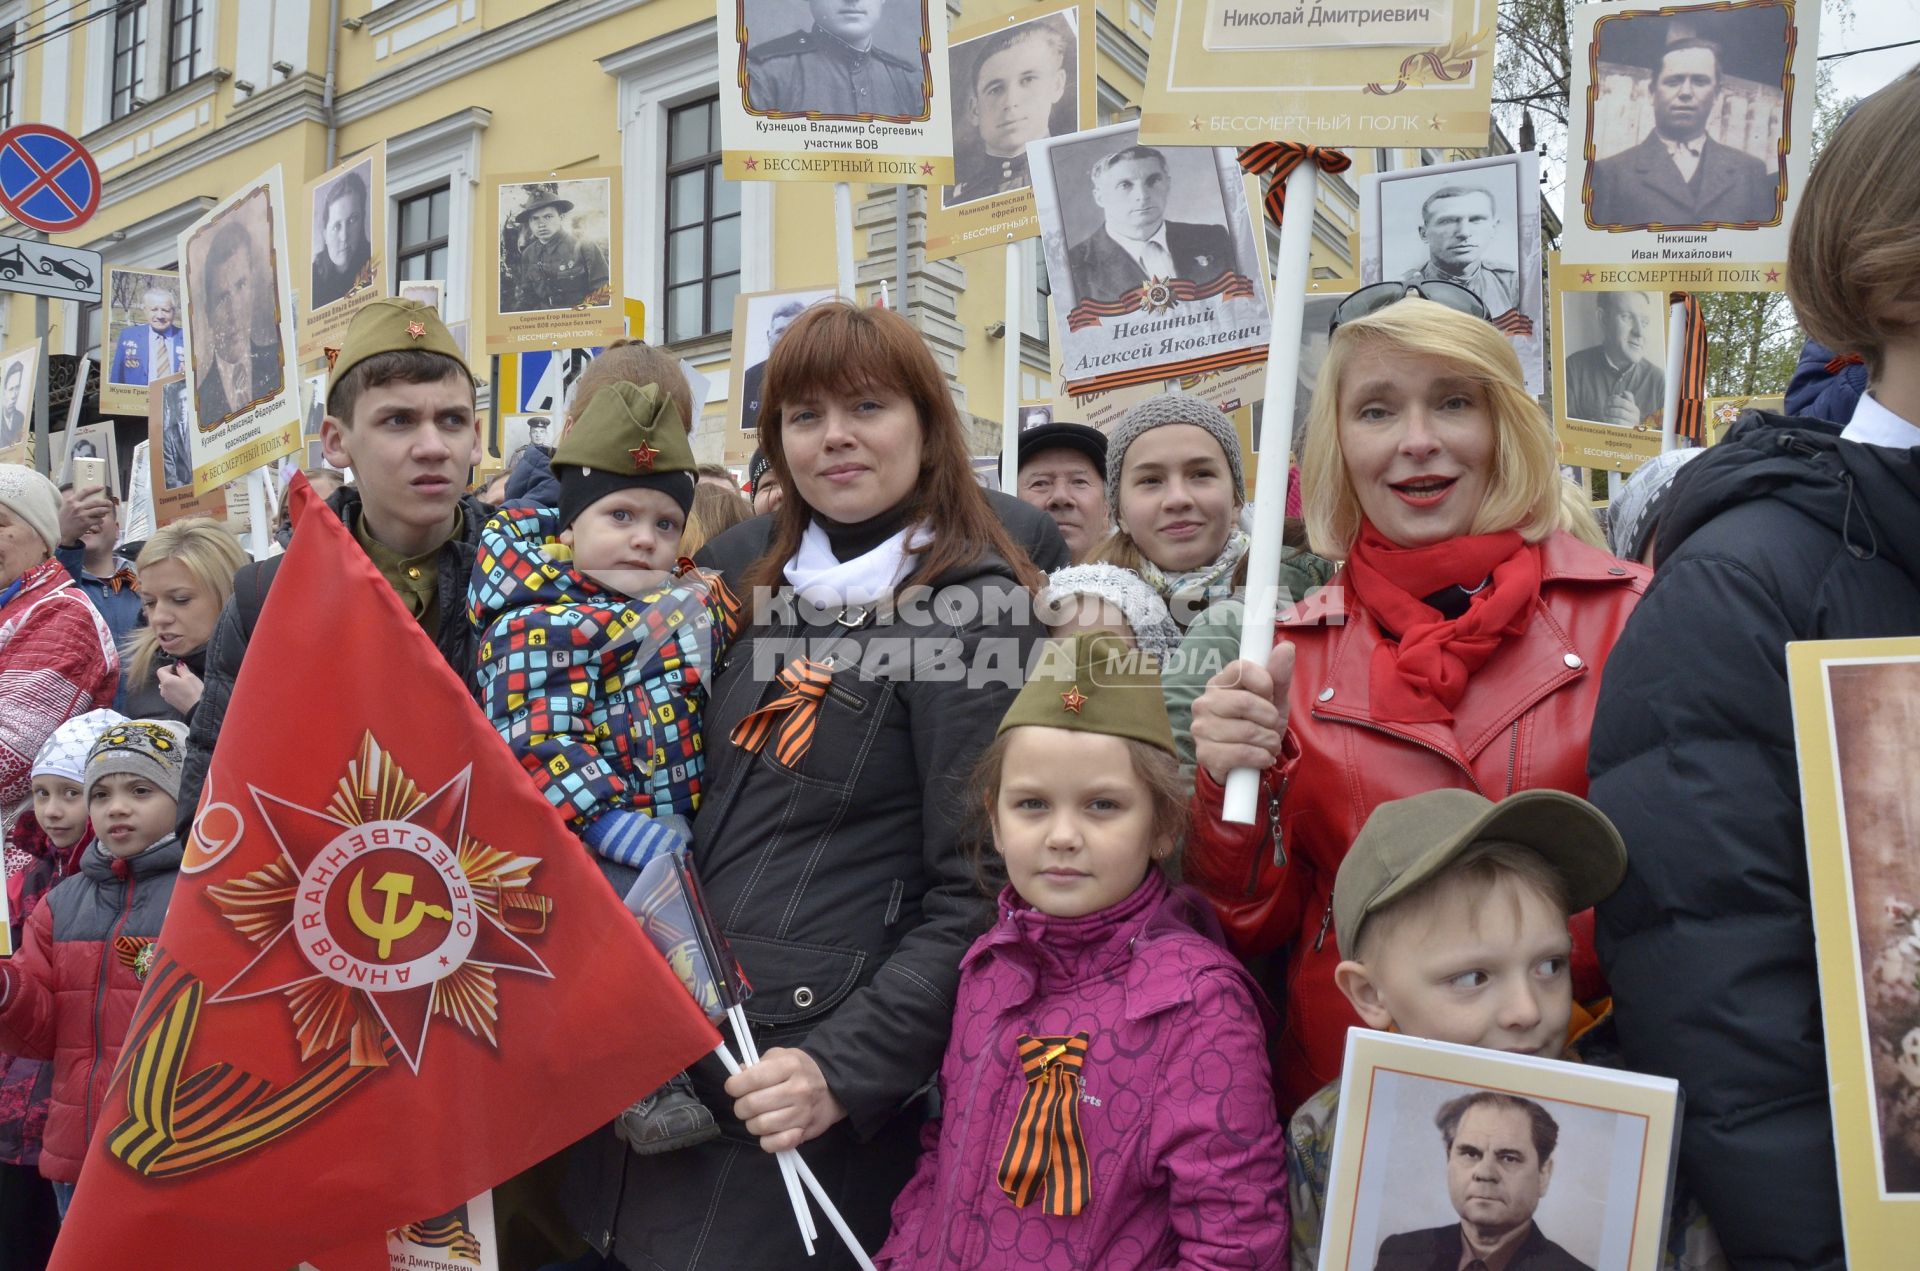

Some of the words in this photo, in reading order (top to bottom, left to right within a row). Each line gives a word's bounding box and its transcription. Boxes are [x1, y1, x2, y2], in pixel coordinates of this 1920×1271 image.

[1223, 6, 1304, 26] Николай
[1308, 6, 1429, 27] Дмитриевич
[756, 120, 807, 133] Кузнецов
[810, 122, 865, 135] Владимир
[868, 124, 924, 136] Сергеевич
[1210, 113, 1350, 131] БЕССМЕРТНЫЙ
[1359, 115, 1420, 130] ПОЛК
[804, 139, 852, 149] участник
[855, 139, 879, 149] ВОВ
[764, 158, 873, 173] БЕССМЕРТНЫЙ
[878, 162, 917, 174] ПОЛК
[963, 217, 1029, 240] БЕССМЕРТНЫЙ
[1656, 233, 1707, 243] Никишин
[1632, 250, 1659, 259] Иван
[1662, 248, 1732, 259] Михайлович
[1600, 268, 1713, 282] БЕССМЕРТНЫЙ
[1718, 270, 1760, 282] ПОЛК
[1112, 307, 1215, 340] Невинный
[1075, 343, 1153, 371] Алексей
[1158, 325, 1261, 355] Яковлевич
[209, 445, 260, 479] БЕССМЕРТНЫЙ
[261, 437, 282, 455] ПОЛК
